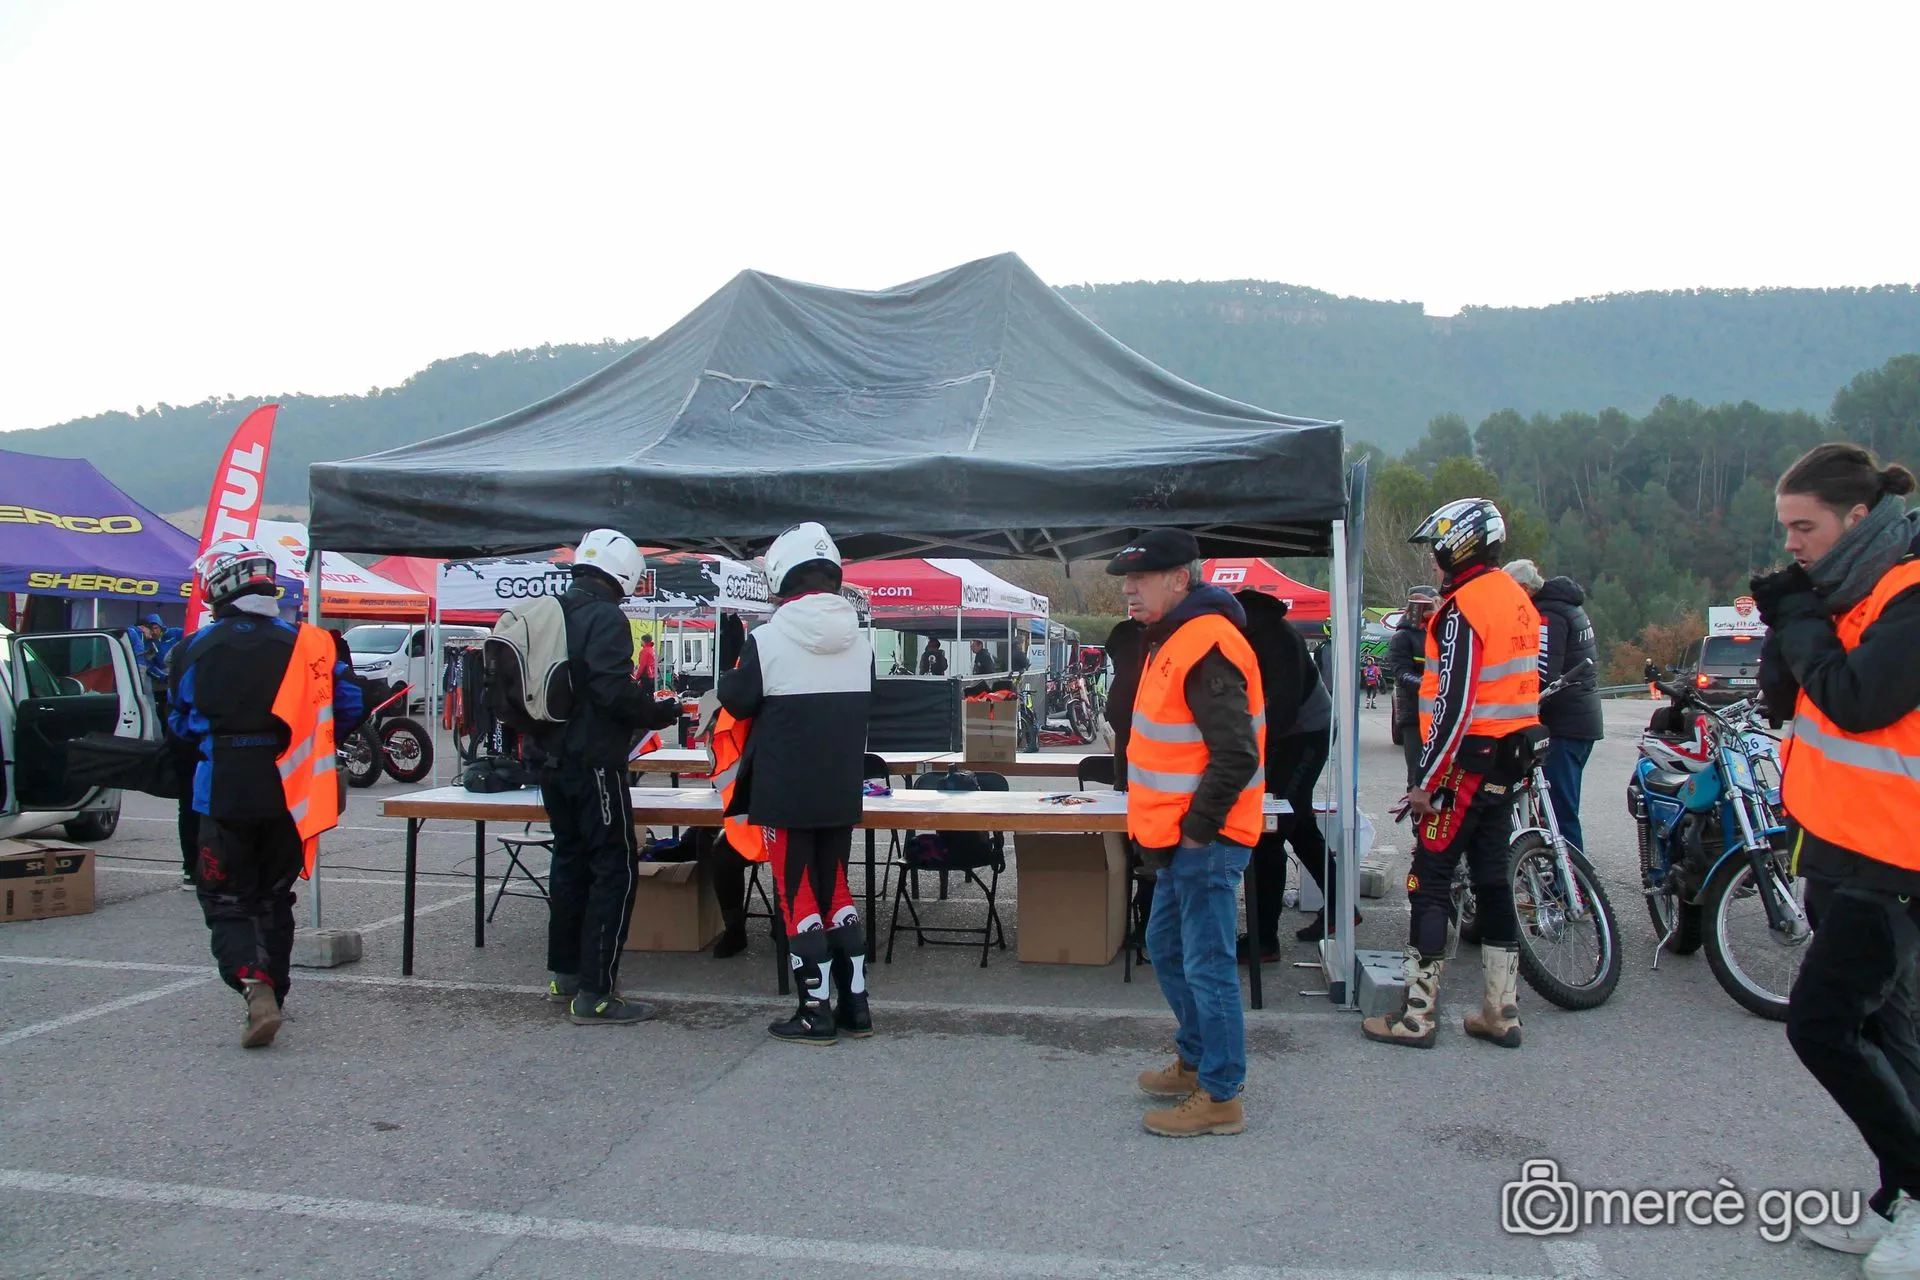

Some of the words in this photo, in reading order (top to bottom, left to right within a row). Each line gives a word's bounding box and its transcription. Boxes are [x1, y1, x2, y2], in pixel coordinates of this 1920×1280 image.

[28, 572, 160, 595] SHERCO
[287, 569, 369, 584] HNDA
[871, 587, 913, 597] .com
